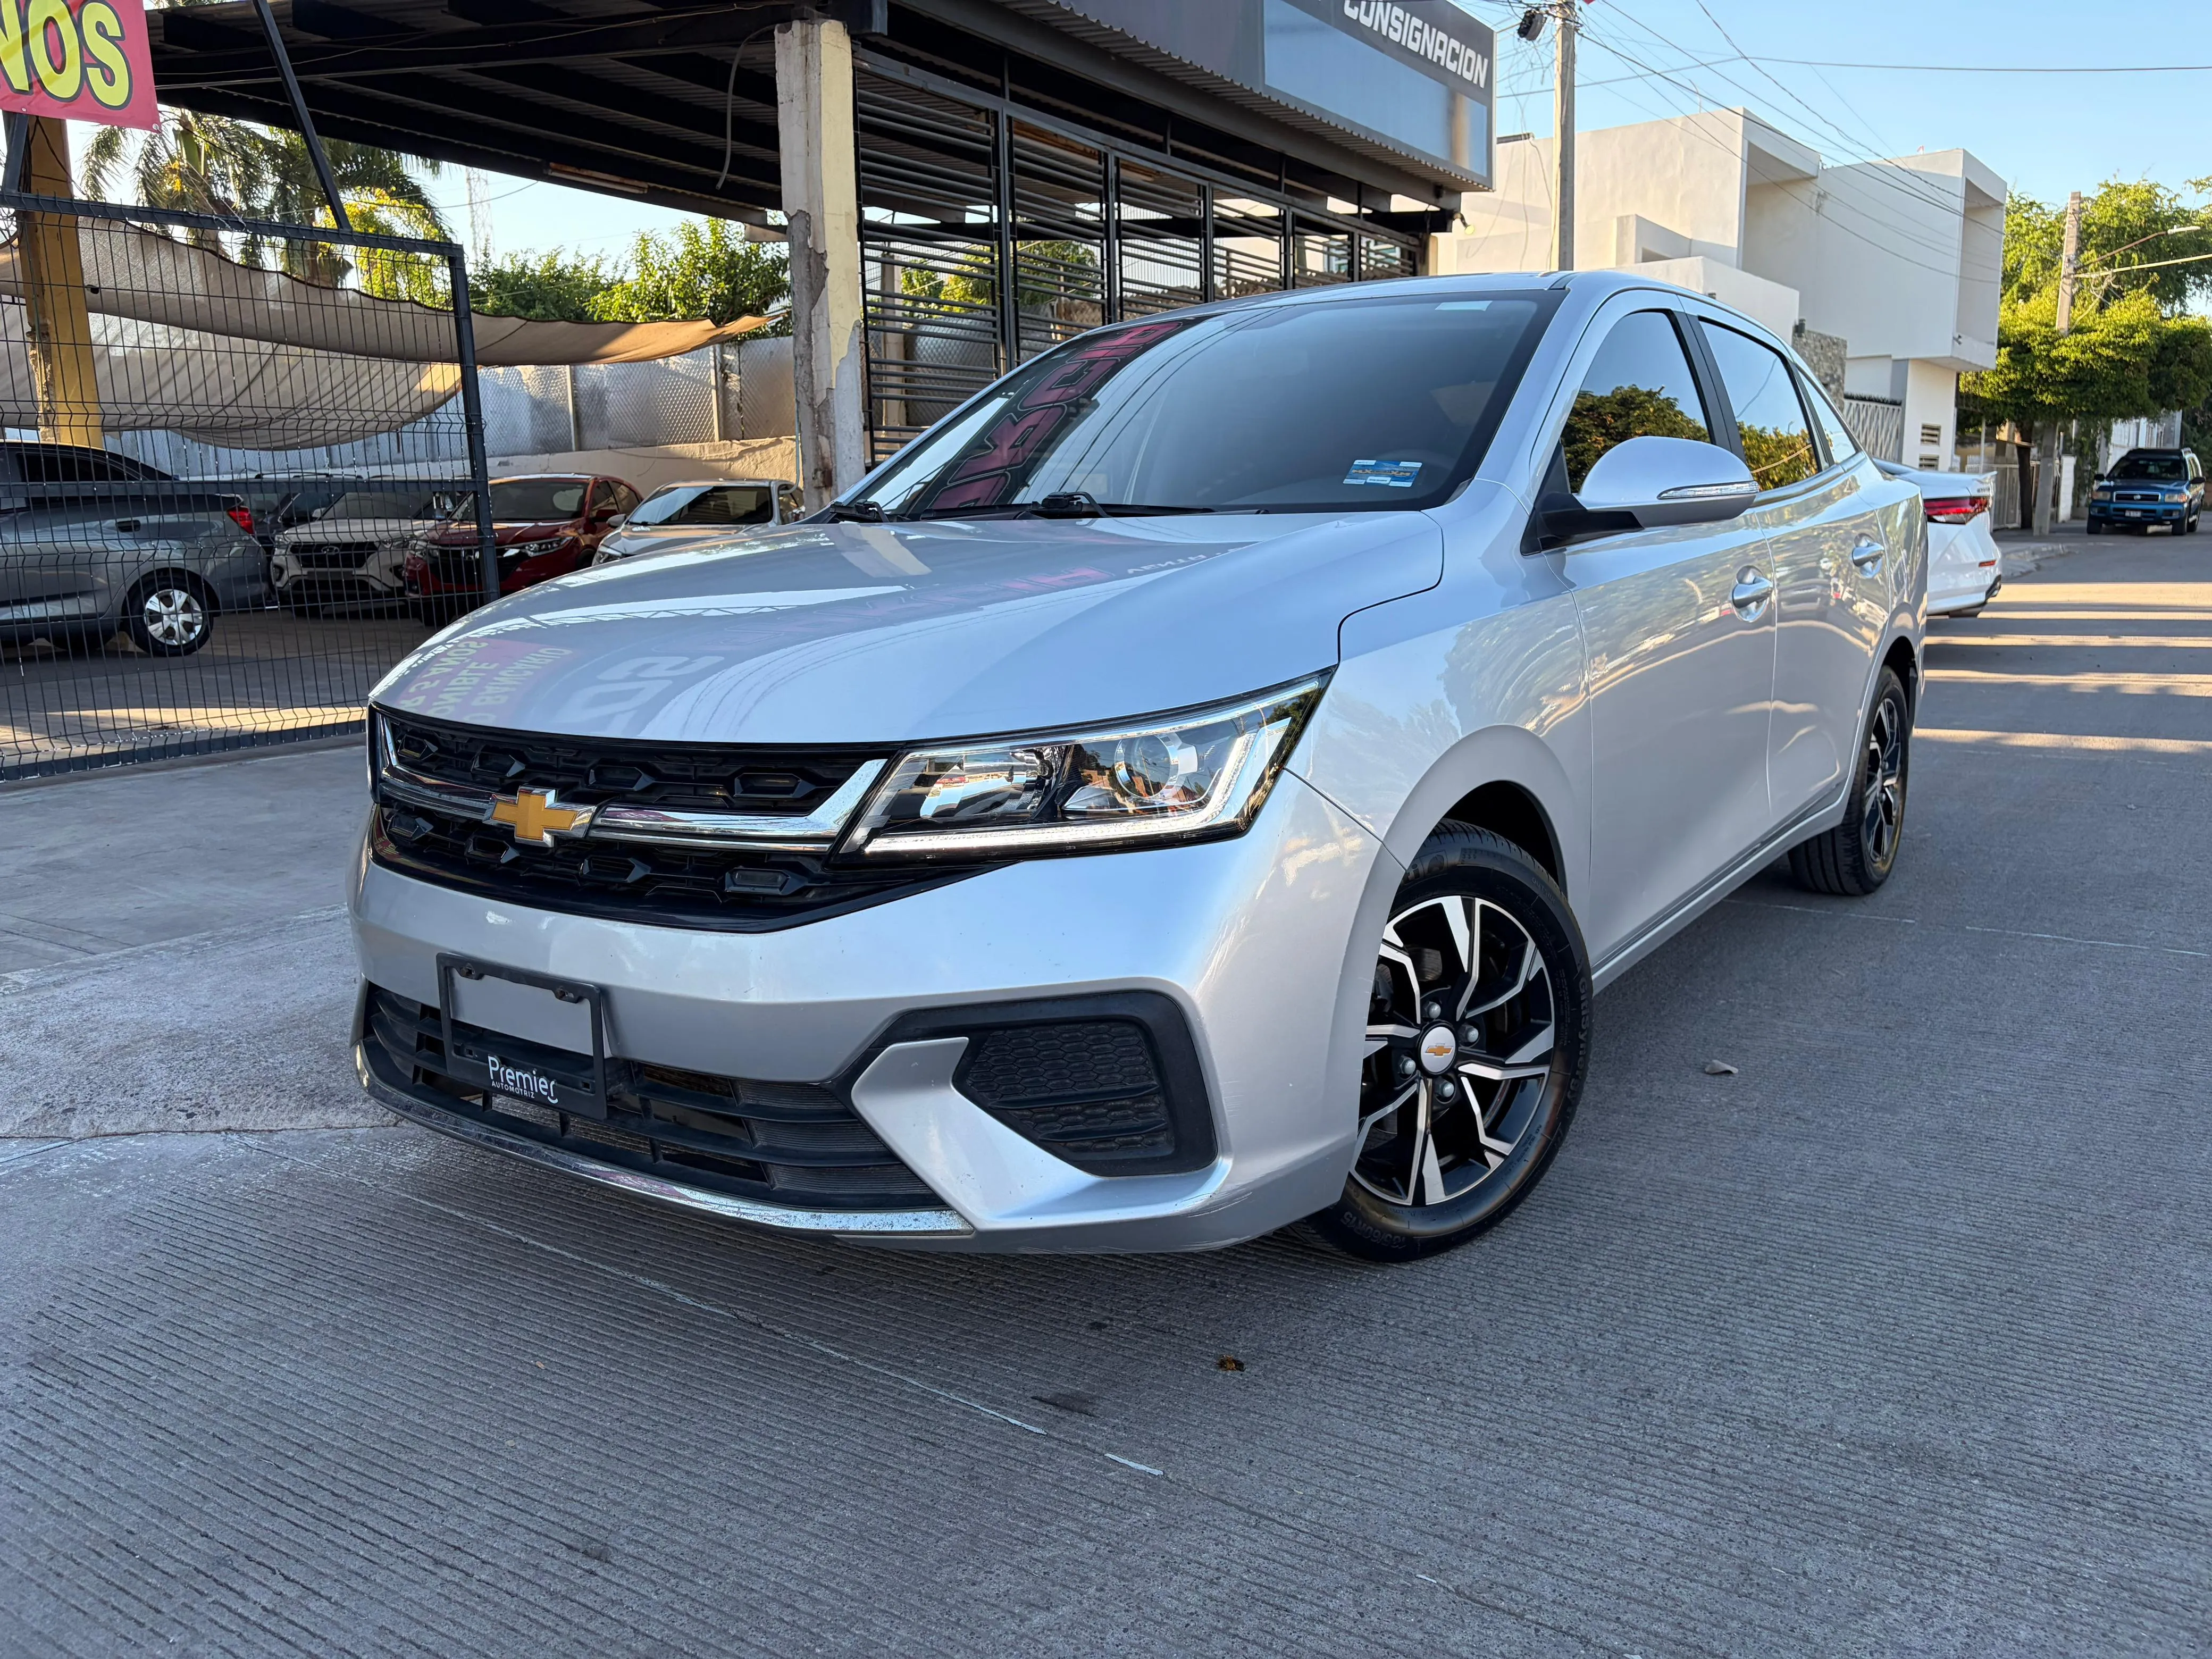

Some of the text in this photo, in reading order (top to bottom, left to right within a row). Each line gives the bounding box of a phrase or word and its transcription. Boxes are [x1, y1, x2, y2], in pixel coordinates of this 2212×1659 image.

[1344, 0, 1488, 88] CONSIGNACION
[488, 1055, 557, 1100] Premier
[492, 1080, 535, 1099] AUTOMOTRIZ
